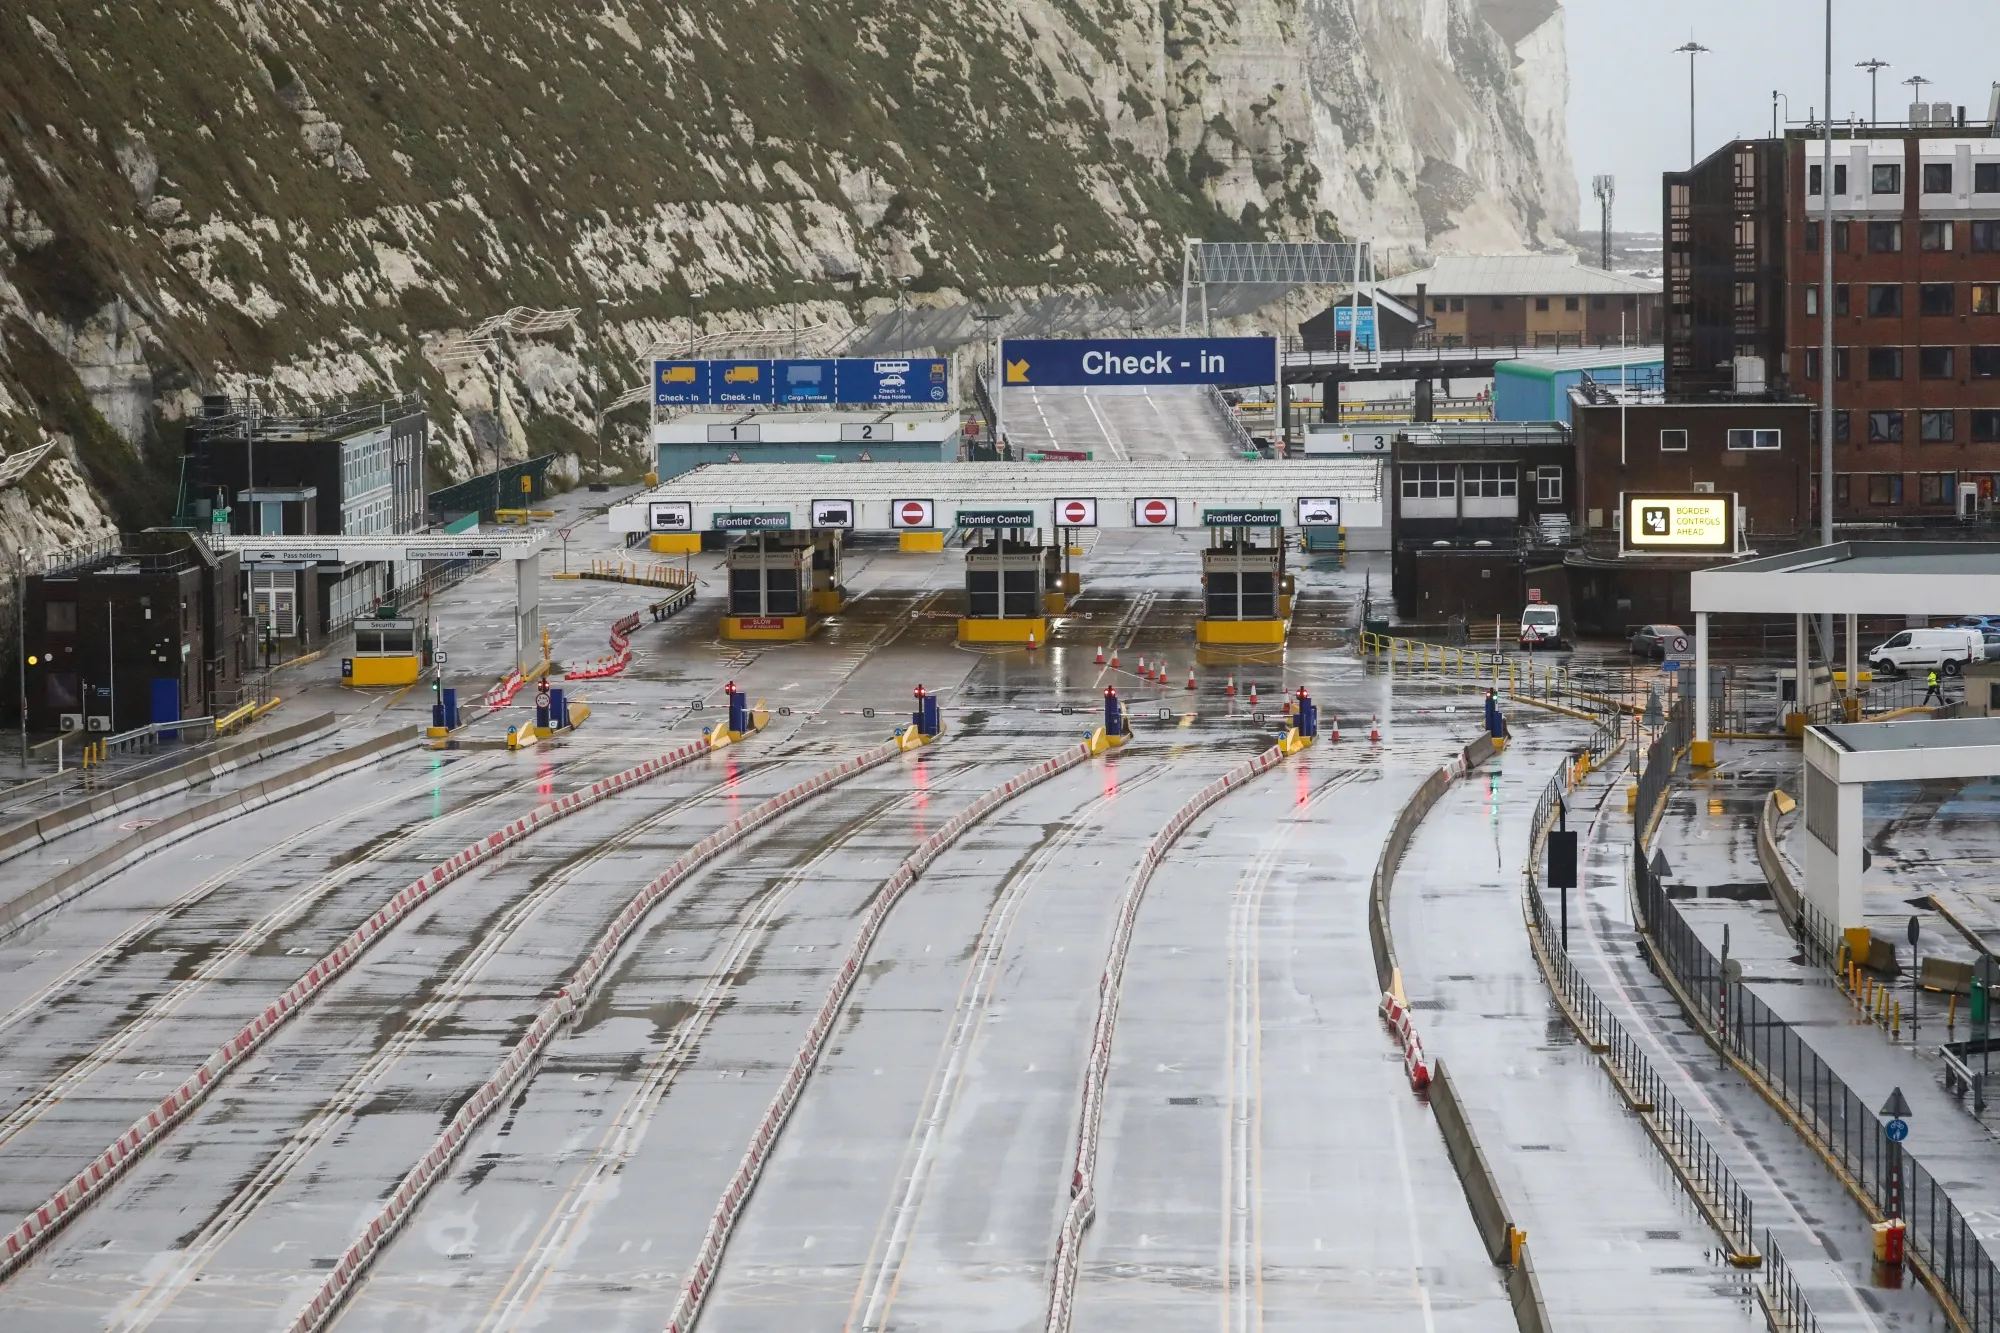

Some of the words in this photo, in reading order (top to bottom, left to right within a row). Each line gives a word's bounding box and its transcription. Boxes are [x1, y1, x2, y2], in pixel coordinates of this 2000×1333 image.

[1082, 350, 1172, 375] Check
[1200, 350, 1225, 374] in
[731, 426, 737, 440] 1
[862, 425, 872, 439] 2
[1374, 436, 1384, 450] 3
[717, 517, 751, 526] Frontier
[754, 516, 788, 526] Control
[998, 515, 1030, 524] Control
[1207, 514, 1242, 522] Frontier
[1244, 514, 1278, 522] Control
